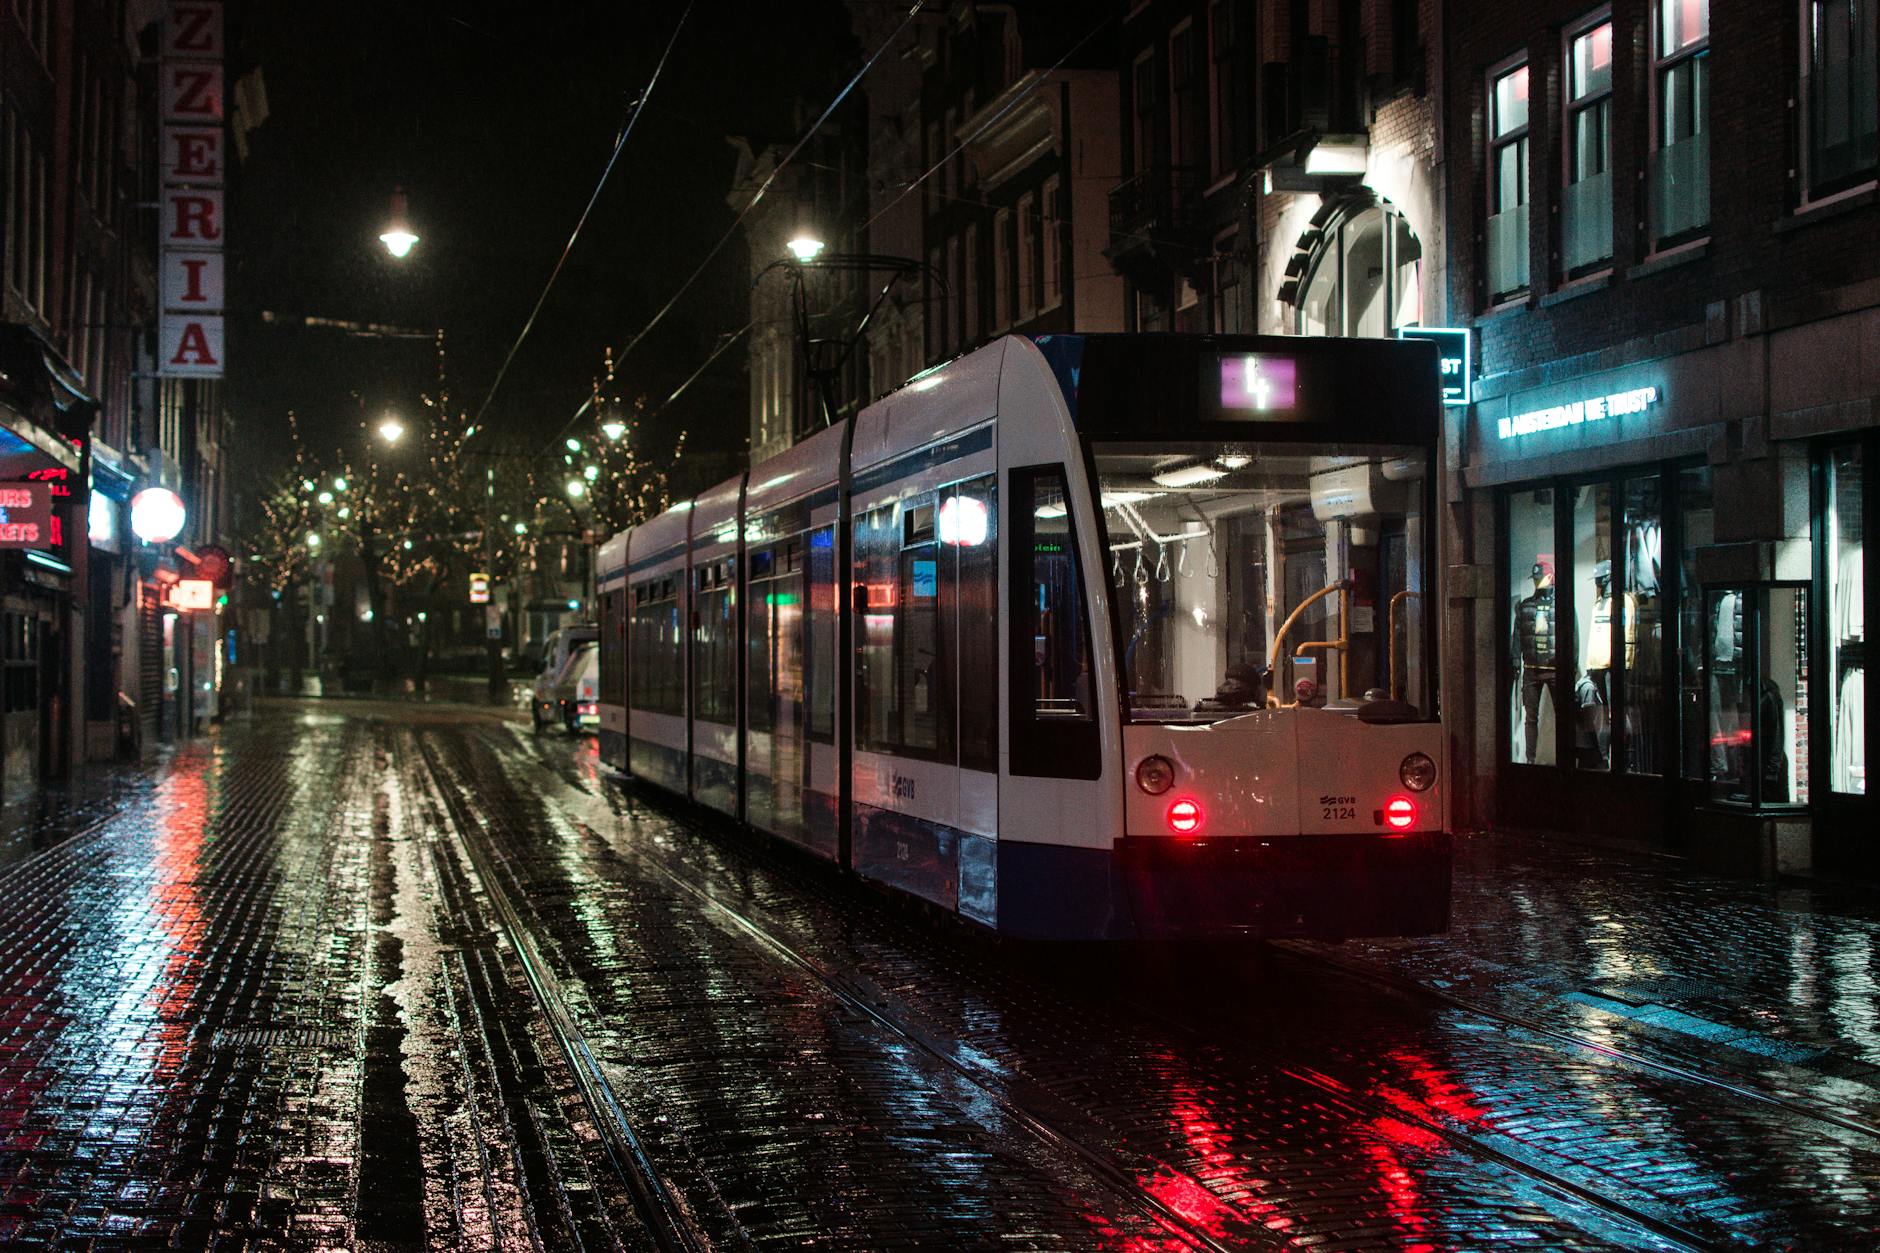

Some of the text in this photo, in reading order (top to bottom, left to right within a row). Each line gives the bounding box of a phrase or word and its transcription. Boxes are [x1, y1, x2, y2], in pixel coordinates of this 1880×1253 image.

[170, 7, 220, 366] ZZERIA
[1246, 357, 1270, 408] 4
[1512, 401, 1584, 436] AMSTERDAM
[1323, 807, 1356, 819] 2124
